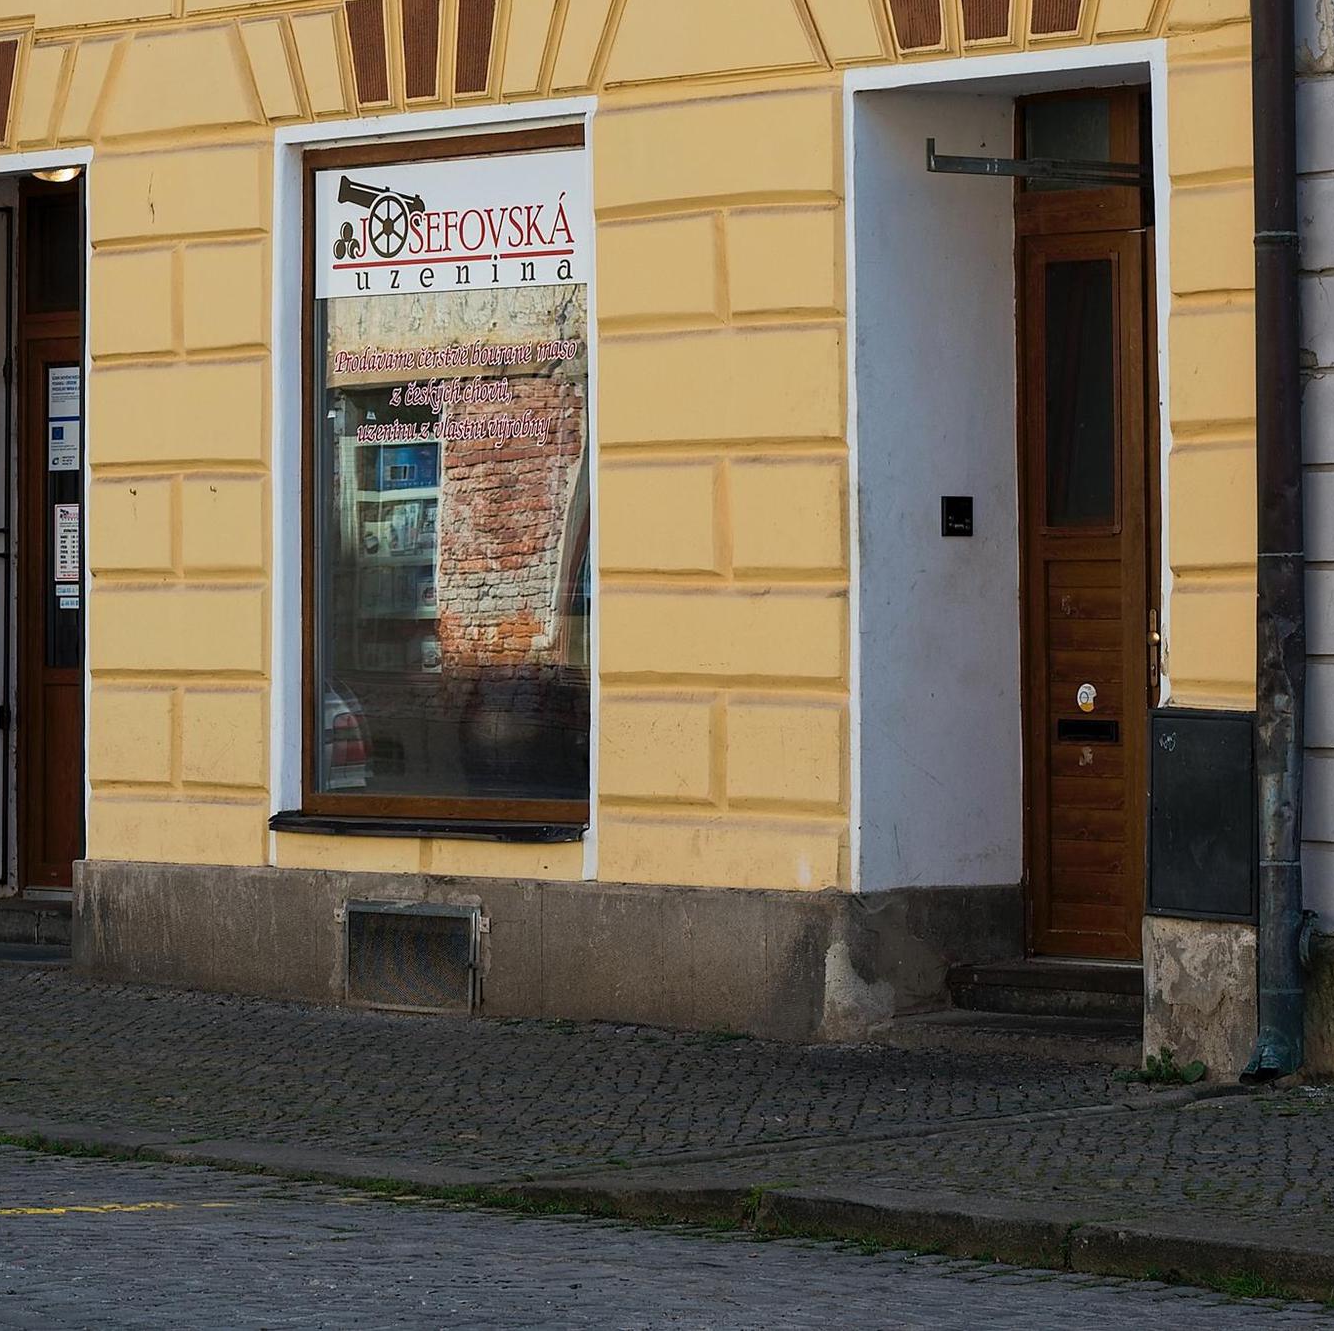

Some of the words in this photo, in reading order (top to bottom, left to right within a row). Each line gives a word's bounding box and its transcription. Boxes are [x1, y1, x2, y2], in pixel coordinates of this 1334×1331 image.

[355, 191, 575, 258] JOSEFOVSKÁ
[355, 255, 574, 290] uzenina
[334, 346, 414, 374] Prodáváme
[417, 345, 469, 369] čerstvě
[470, 339, 532, 367] bourané
[537, 340, 578, 362] maso
[389, 386, 402, 407] z
[404, 377, 461, 414] českých
[357, 418, 417, 444] uzeninu
[418, 422, 430, 441] z
[488, 409, 553, 448] výrobny
